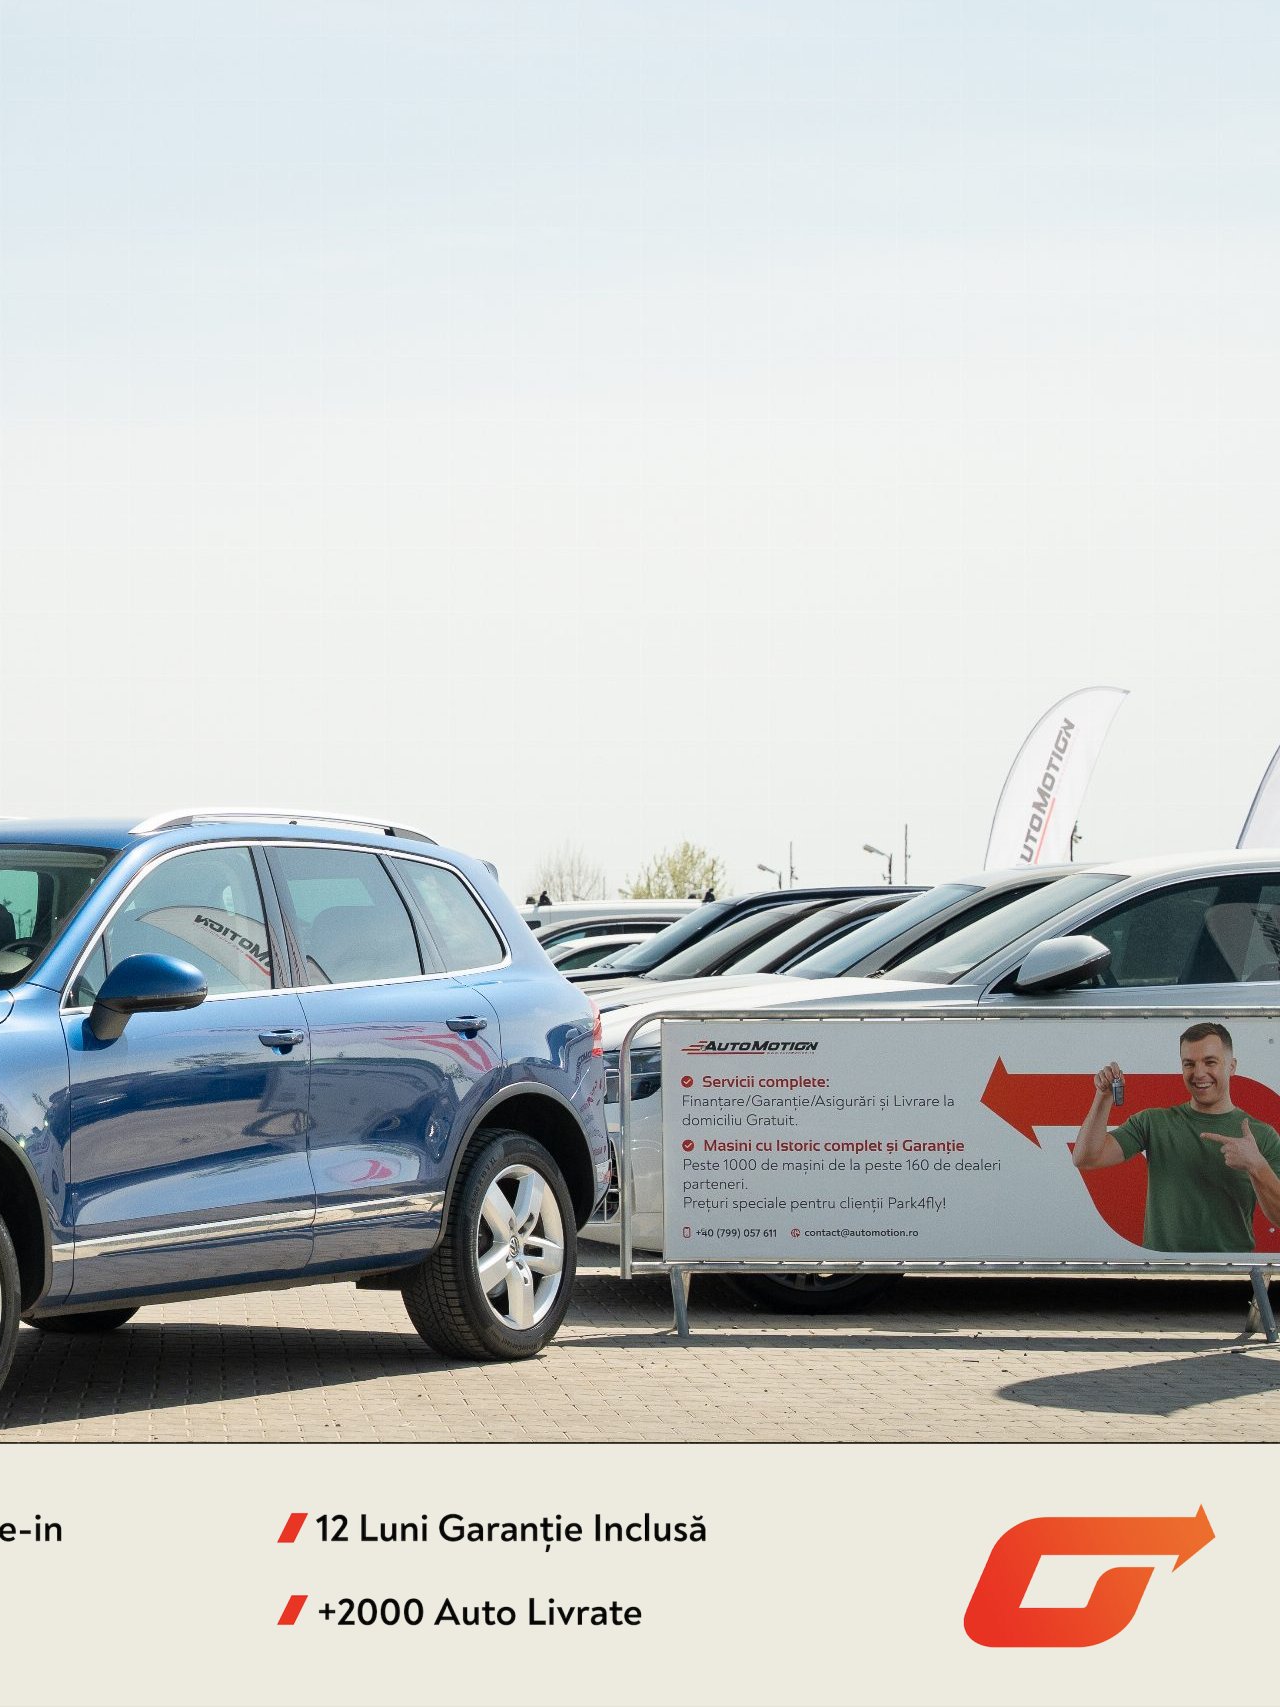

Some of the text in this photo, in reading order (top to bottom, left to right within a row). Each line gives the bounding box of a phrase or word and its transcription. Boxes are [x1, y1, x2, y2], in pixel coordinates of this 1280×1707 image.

[702, 1075, 830, 1091] Servicii complete:
[682, 1094, 955, 1111] Finanțare/Garanție/Asigurări și Livrare la
[682, 1113, 798, 1126] domiciliu Gratuit.
[703, 1139, 965, 1155] Masini cu Istoric complet și Garanție
[683, 1158, 1001, 1175] Peste 1000 de mașini de la peste 160 de dealeri
[683, 1178, 748, 1193] parteneri.
[683, 1196, 946, 1214] Prețuri speciale pentru clienții Park4fly!
[695, 1228, 777, 1240] +40 (799) 057 611
[804, 1227, 919, 1239] contact@automotion.ro
